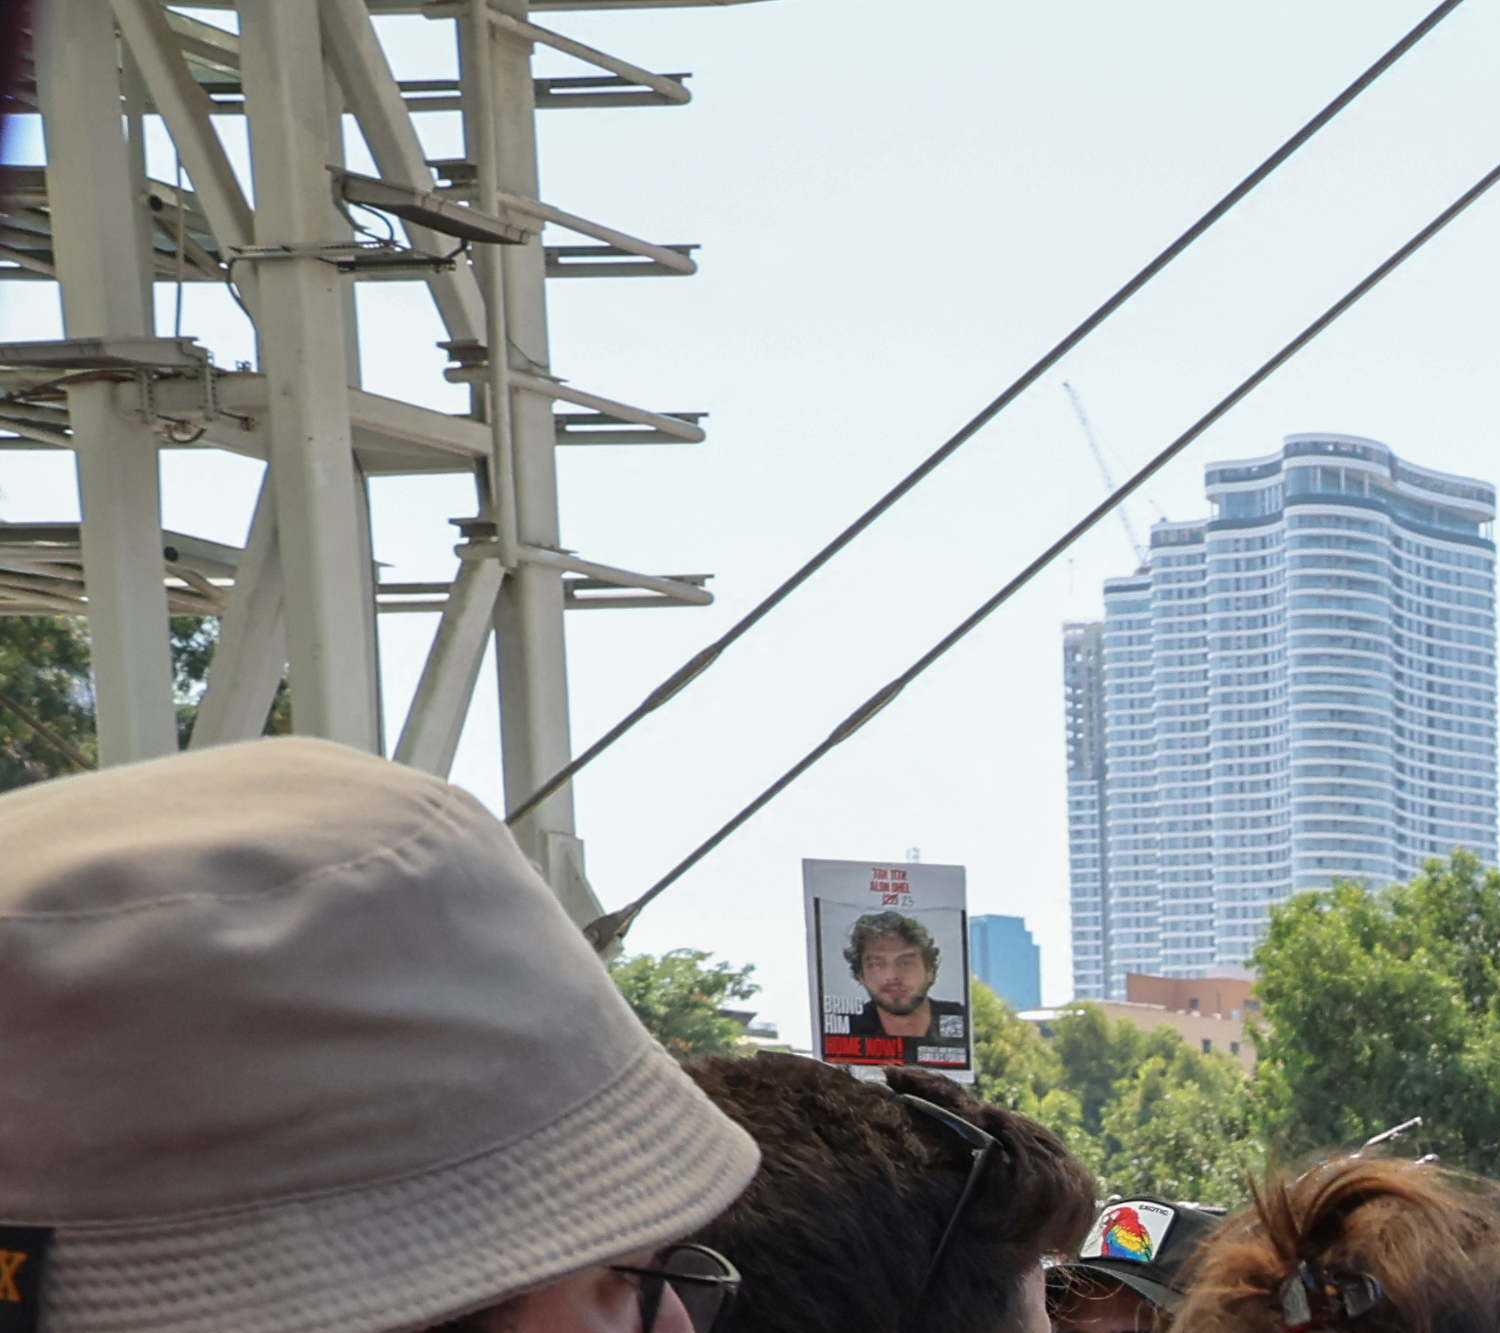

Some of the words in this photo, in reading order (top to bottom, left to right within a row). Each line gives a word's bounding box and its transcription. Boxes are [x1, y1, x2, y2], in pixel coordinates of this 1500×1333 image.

[824, 995, 864, 1015] BRING
[825, 1014, 851, 1034] HIM
[824, 1036, 863, 1056] HOME
[1138, 1204, 1170, 1217] EXOTIC
